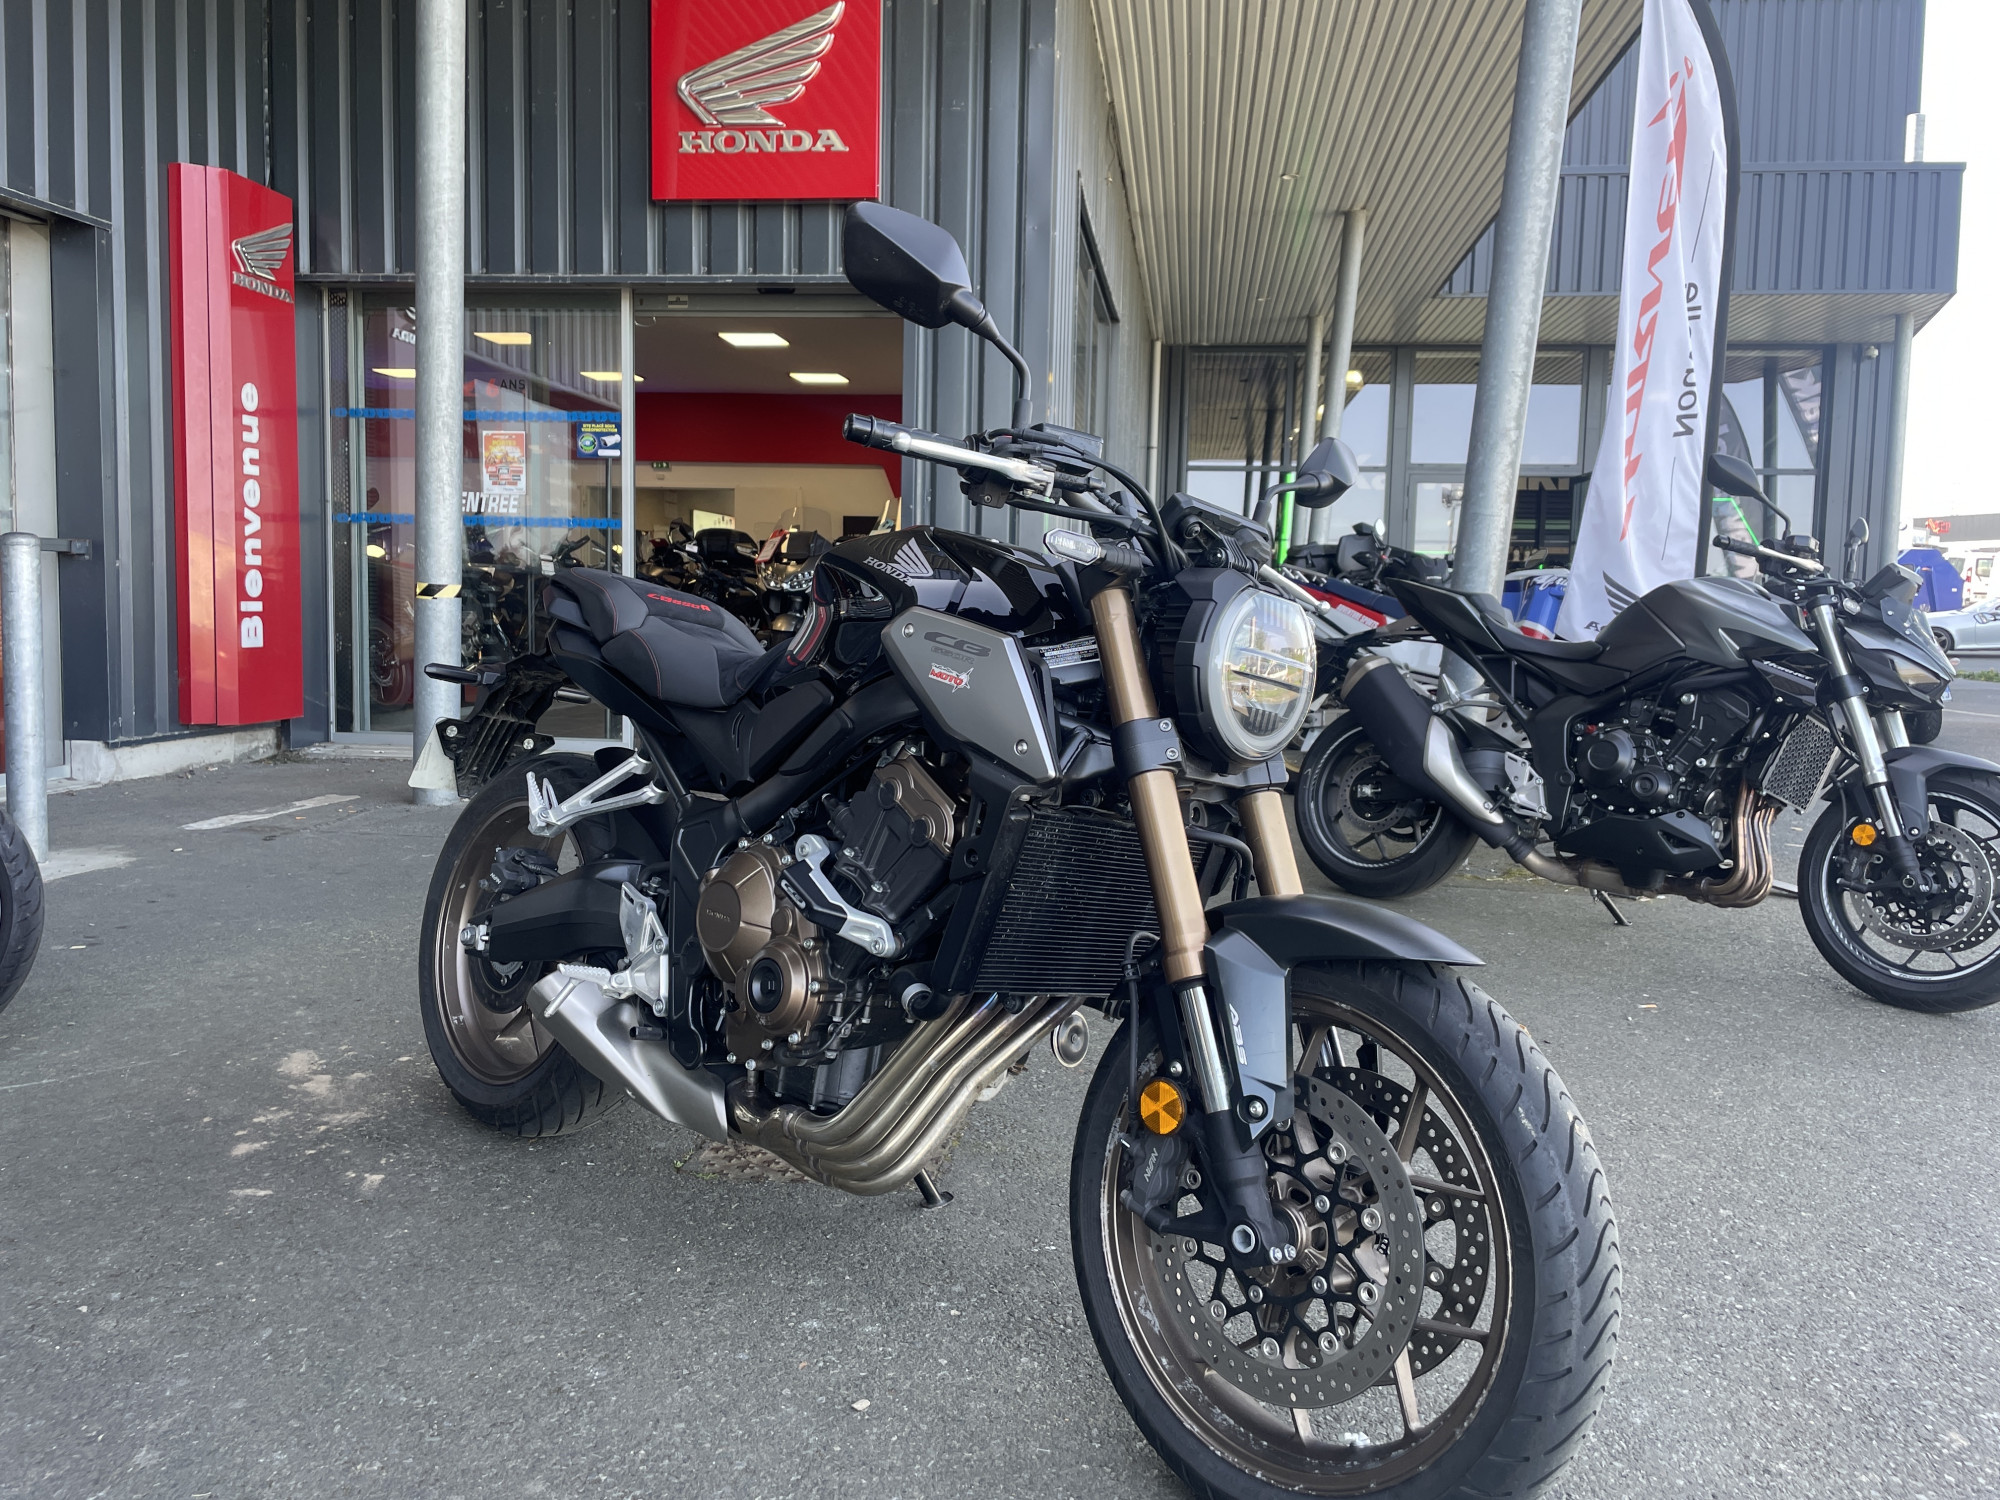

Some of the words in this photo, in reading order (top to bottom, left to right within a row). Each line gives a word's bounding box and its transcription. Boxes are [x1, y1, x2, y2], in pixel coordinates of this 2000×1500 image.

[678, 129, 849, 154] HONDA
[232, 271, 294, 303] HONDA
[500, 379, 526, 390] ANS
[240, 382, 264, 649] Bienvenue
[862, 556, 914, 587] HONDA
[647, 593, 712, 612] CB650R
[923, 631, 992, 657] CB
[930, 668, 964, 686] MOTO
[1229, 1003, 1248, 1066] ABS
